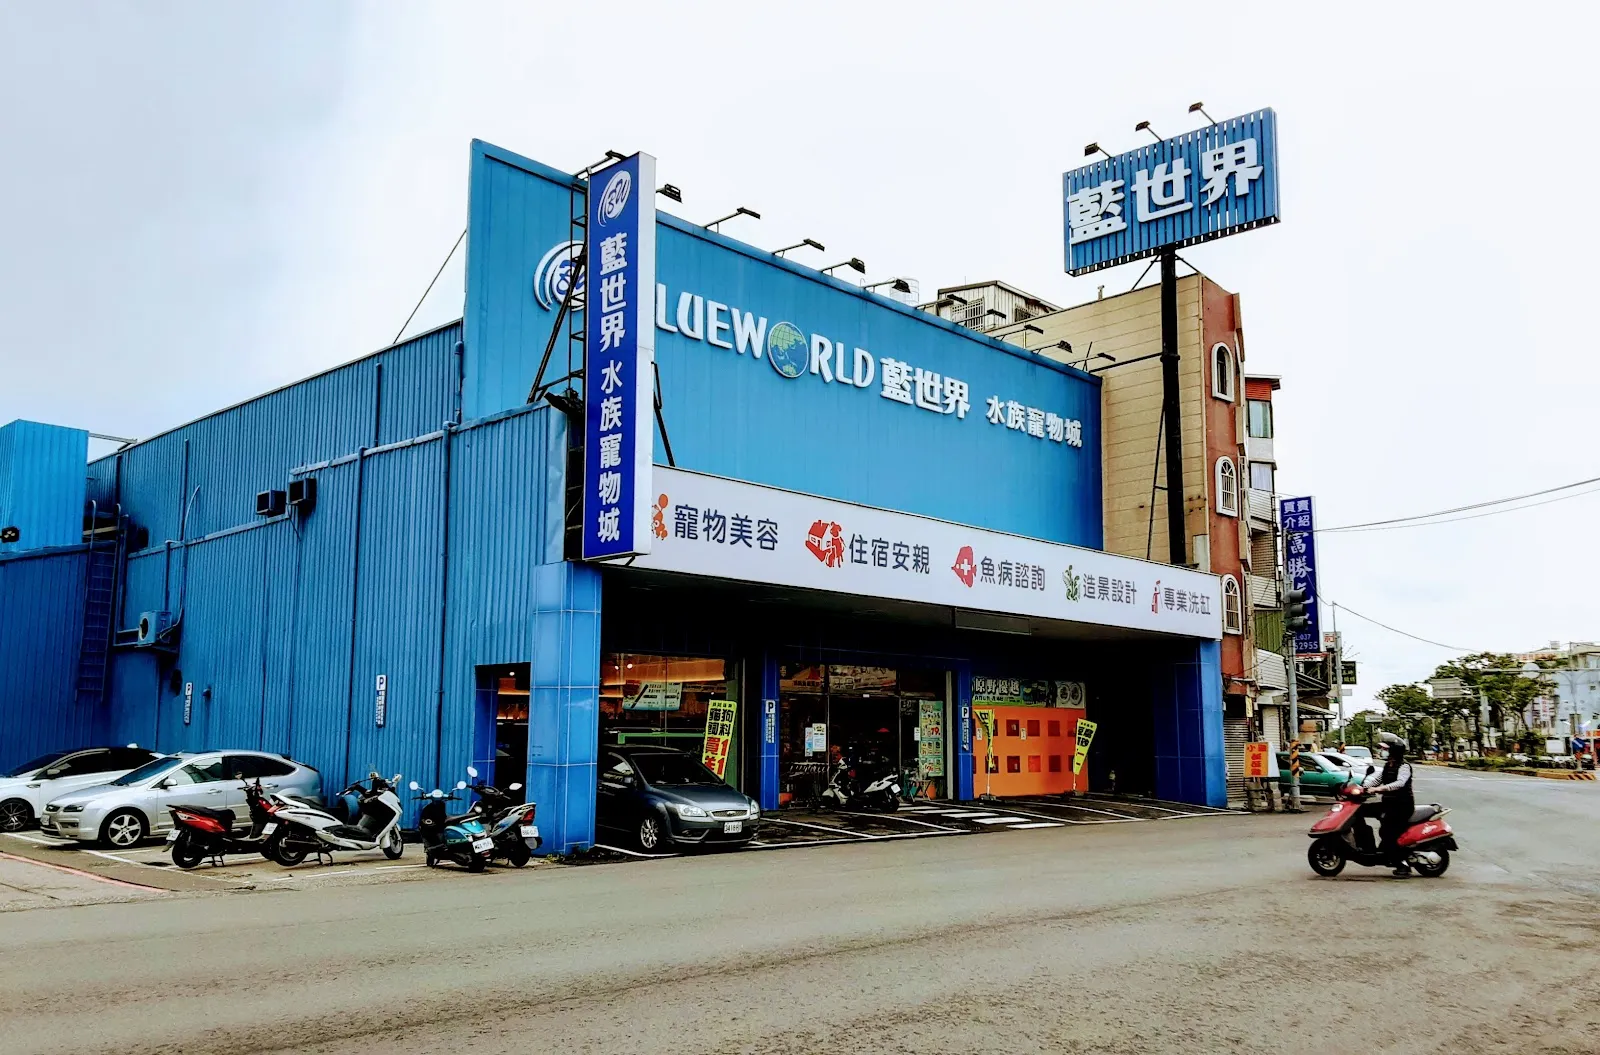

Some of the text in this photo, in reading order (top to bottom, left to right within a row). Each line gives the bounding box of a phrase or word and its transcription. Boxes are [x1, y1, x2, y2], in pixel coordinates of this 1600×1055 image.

[1066, 138, 1263, 245] 藍世界
[597, 232, 628, 543] 藍世界 水族寵物城
[879, 357, 971, 419] 藍世界
[985, 395, 1083, 448] 水族寵物城
[674, 503, 1211, 616] 寵物美容 住宿安親 魚病諮詢 造景設計 專業洗缸
[767, 701, 774, 713] P
